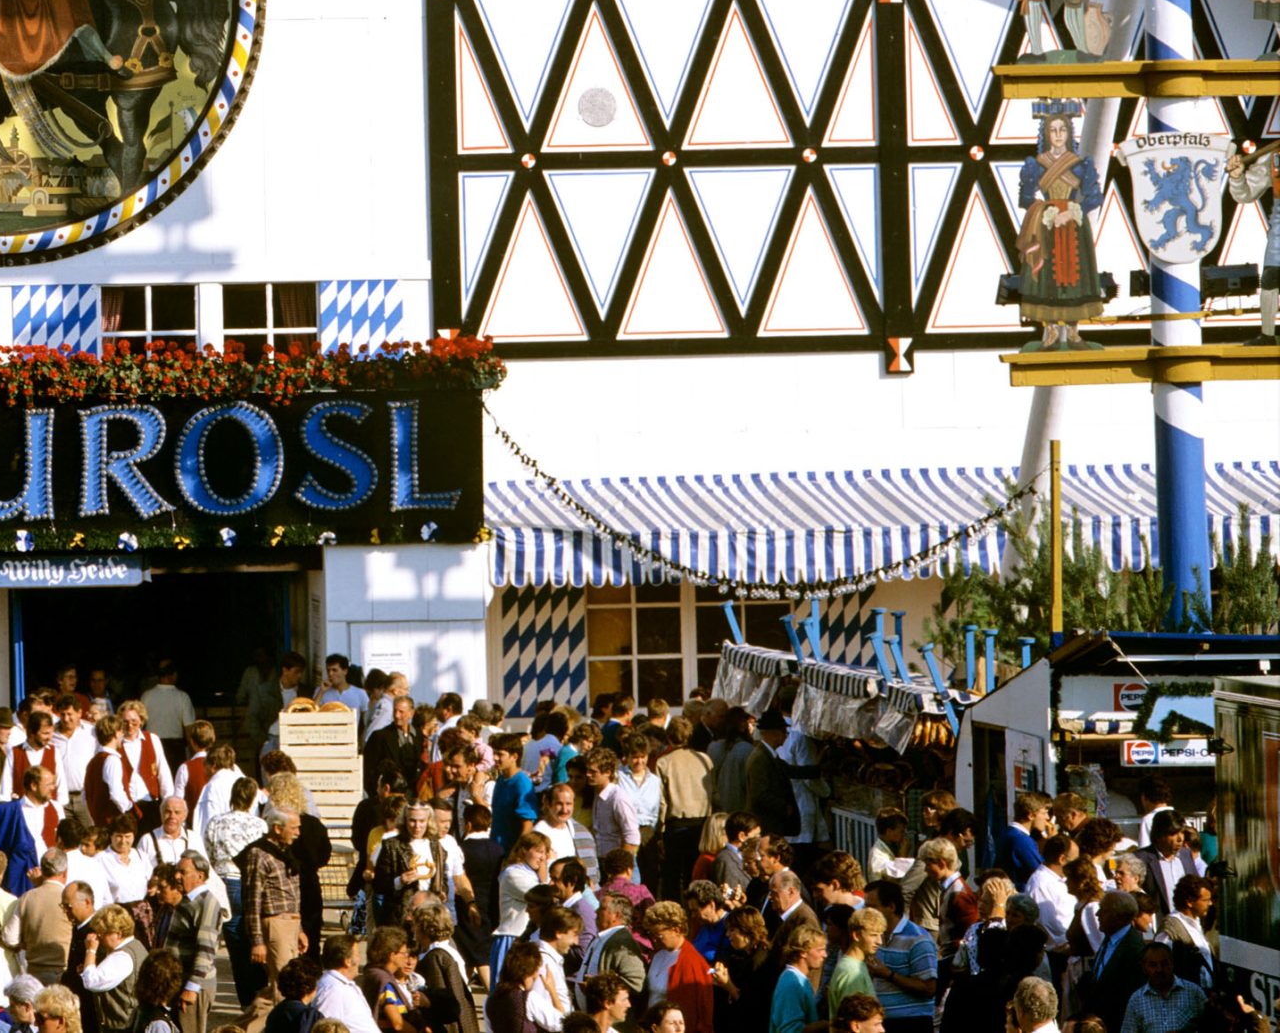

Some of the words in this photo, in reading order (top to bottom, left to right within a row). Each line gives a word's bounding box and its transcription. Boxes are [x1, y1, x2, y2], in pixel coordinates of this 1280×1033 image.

[1135, 132, 1211, 149] Oberpfalz
[0, 559, 64, 585] Willy
[1121, 693, 1145, 701] PEPS
